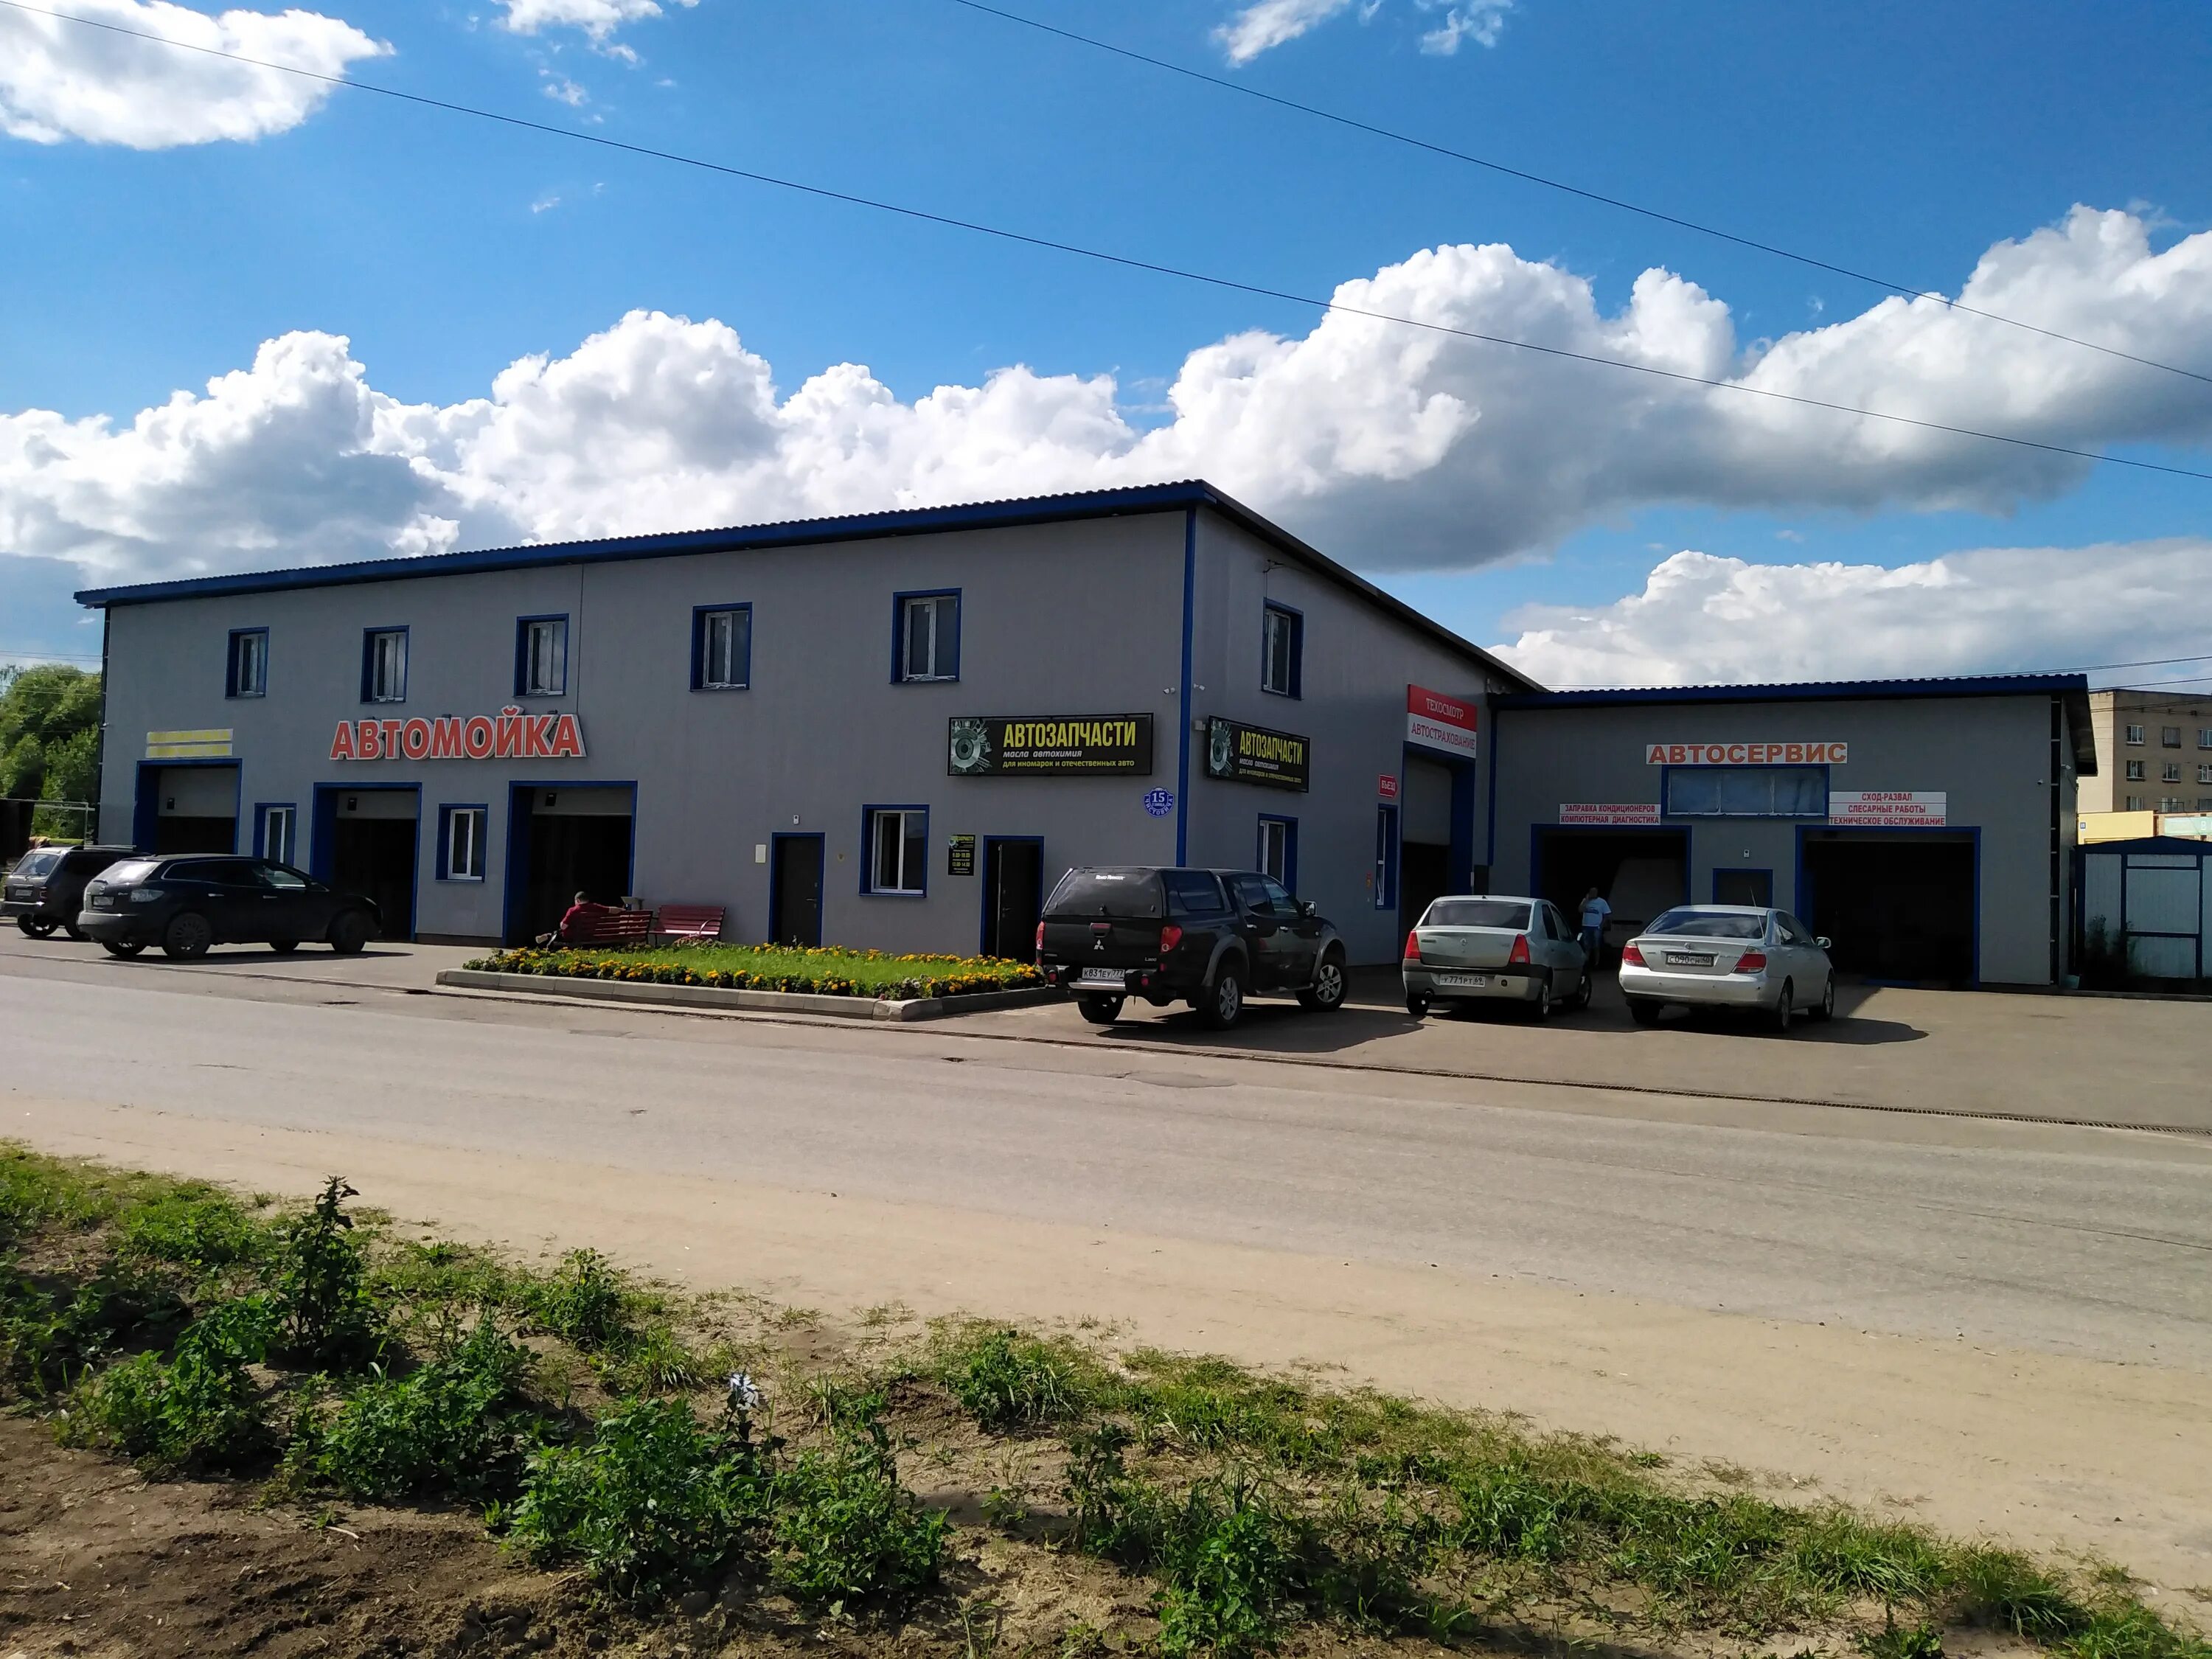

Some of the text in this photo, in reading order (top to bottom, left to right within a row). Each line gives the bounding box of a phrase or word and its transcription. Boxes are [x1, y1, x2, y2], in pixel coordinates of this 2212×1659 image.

[1426, 698, 1464, 720] ТЕХОСМОТР
[330, 705, 586, 760] АВТОМОЙКА
[1003, 721, 1136, 748] АВТОЗАПЧАСТИ
[1411, 722, 1475, 750] АВТОСТРАХОВАНИЕ
[1239, 731, 1303, 765] АВТОЗАПЧАСТИ
[1648, 743, 1846, 763] АВТОСЕРВИС
[1381, 780, 1396, 791] ВЪЕЗД
[1152, 793, 1165, 802] 15
[1862, 793, 1913, 802] СХОД-РАЗВАЛ
[1565, 804, 1655, 813] ЗАПРАВКА КОНДИЦИОНЕРОВ
[1848, 804, 1926, 813] СЛЕСАРНЫЕ РАБОТЫ
[1613, 815, 1659, 824] ДИАГНОСТИКА
[1829, 817, 1945, 826] ТЕХНИЧЕСКОЕ ОБСЛУЖИВАНИЕ
[1084, 969, 1111, 978] К831ЕУ
